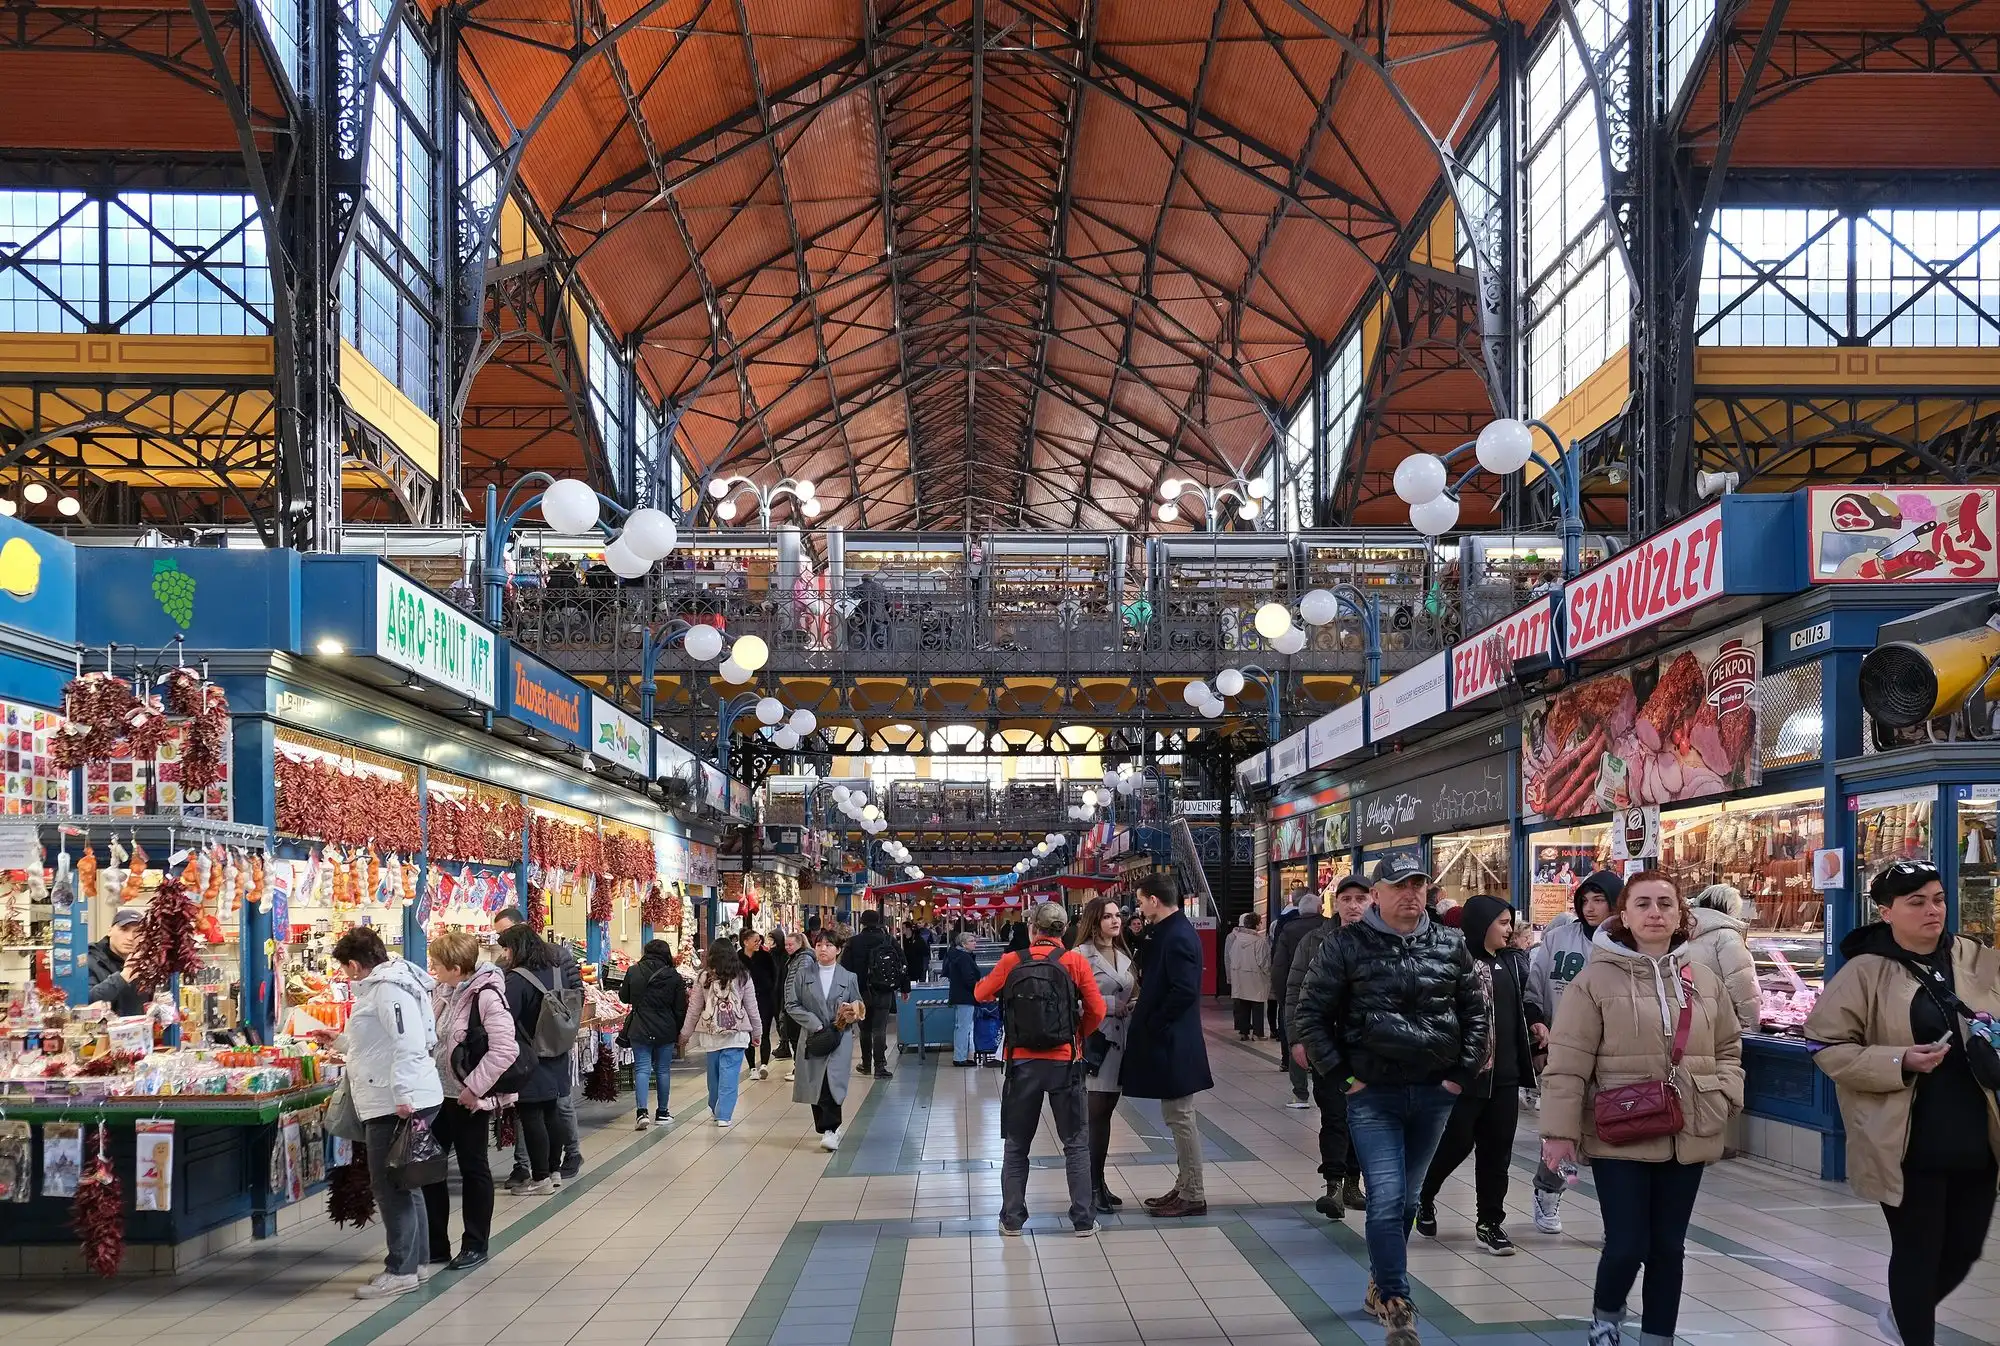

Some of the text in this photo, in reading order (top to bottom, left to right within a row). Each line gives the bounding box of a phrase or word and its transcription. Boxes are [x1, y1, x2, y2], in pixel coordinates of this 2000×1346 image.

[1569, 518, 1723, 649] SZAKÜZLET
[386, 580, 492, 697] AGRO-FRUIT KFT.
[1454, 607, 1551, 700] FELVÁGOTT
[1795, 625, 1826, 647] C-II/3.
[1712, 658, 1753, 687] PEKPOL
[1549, 950, 1586, 982] 18
